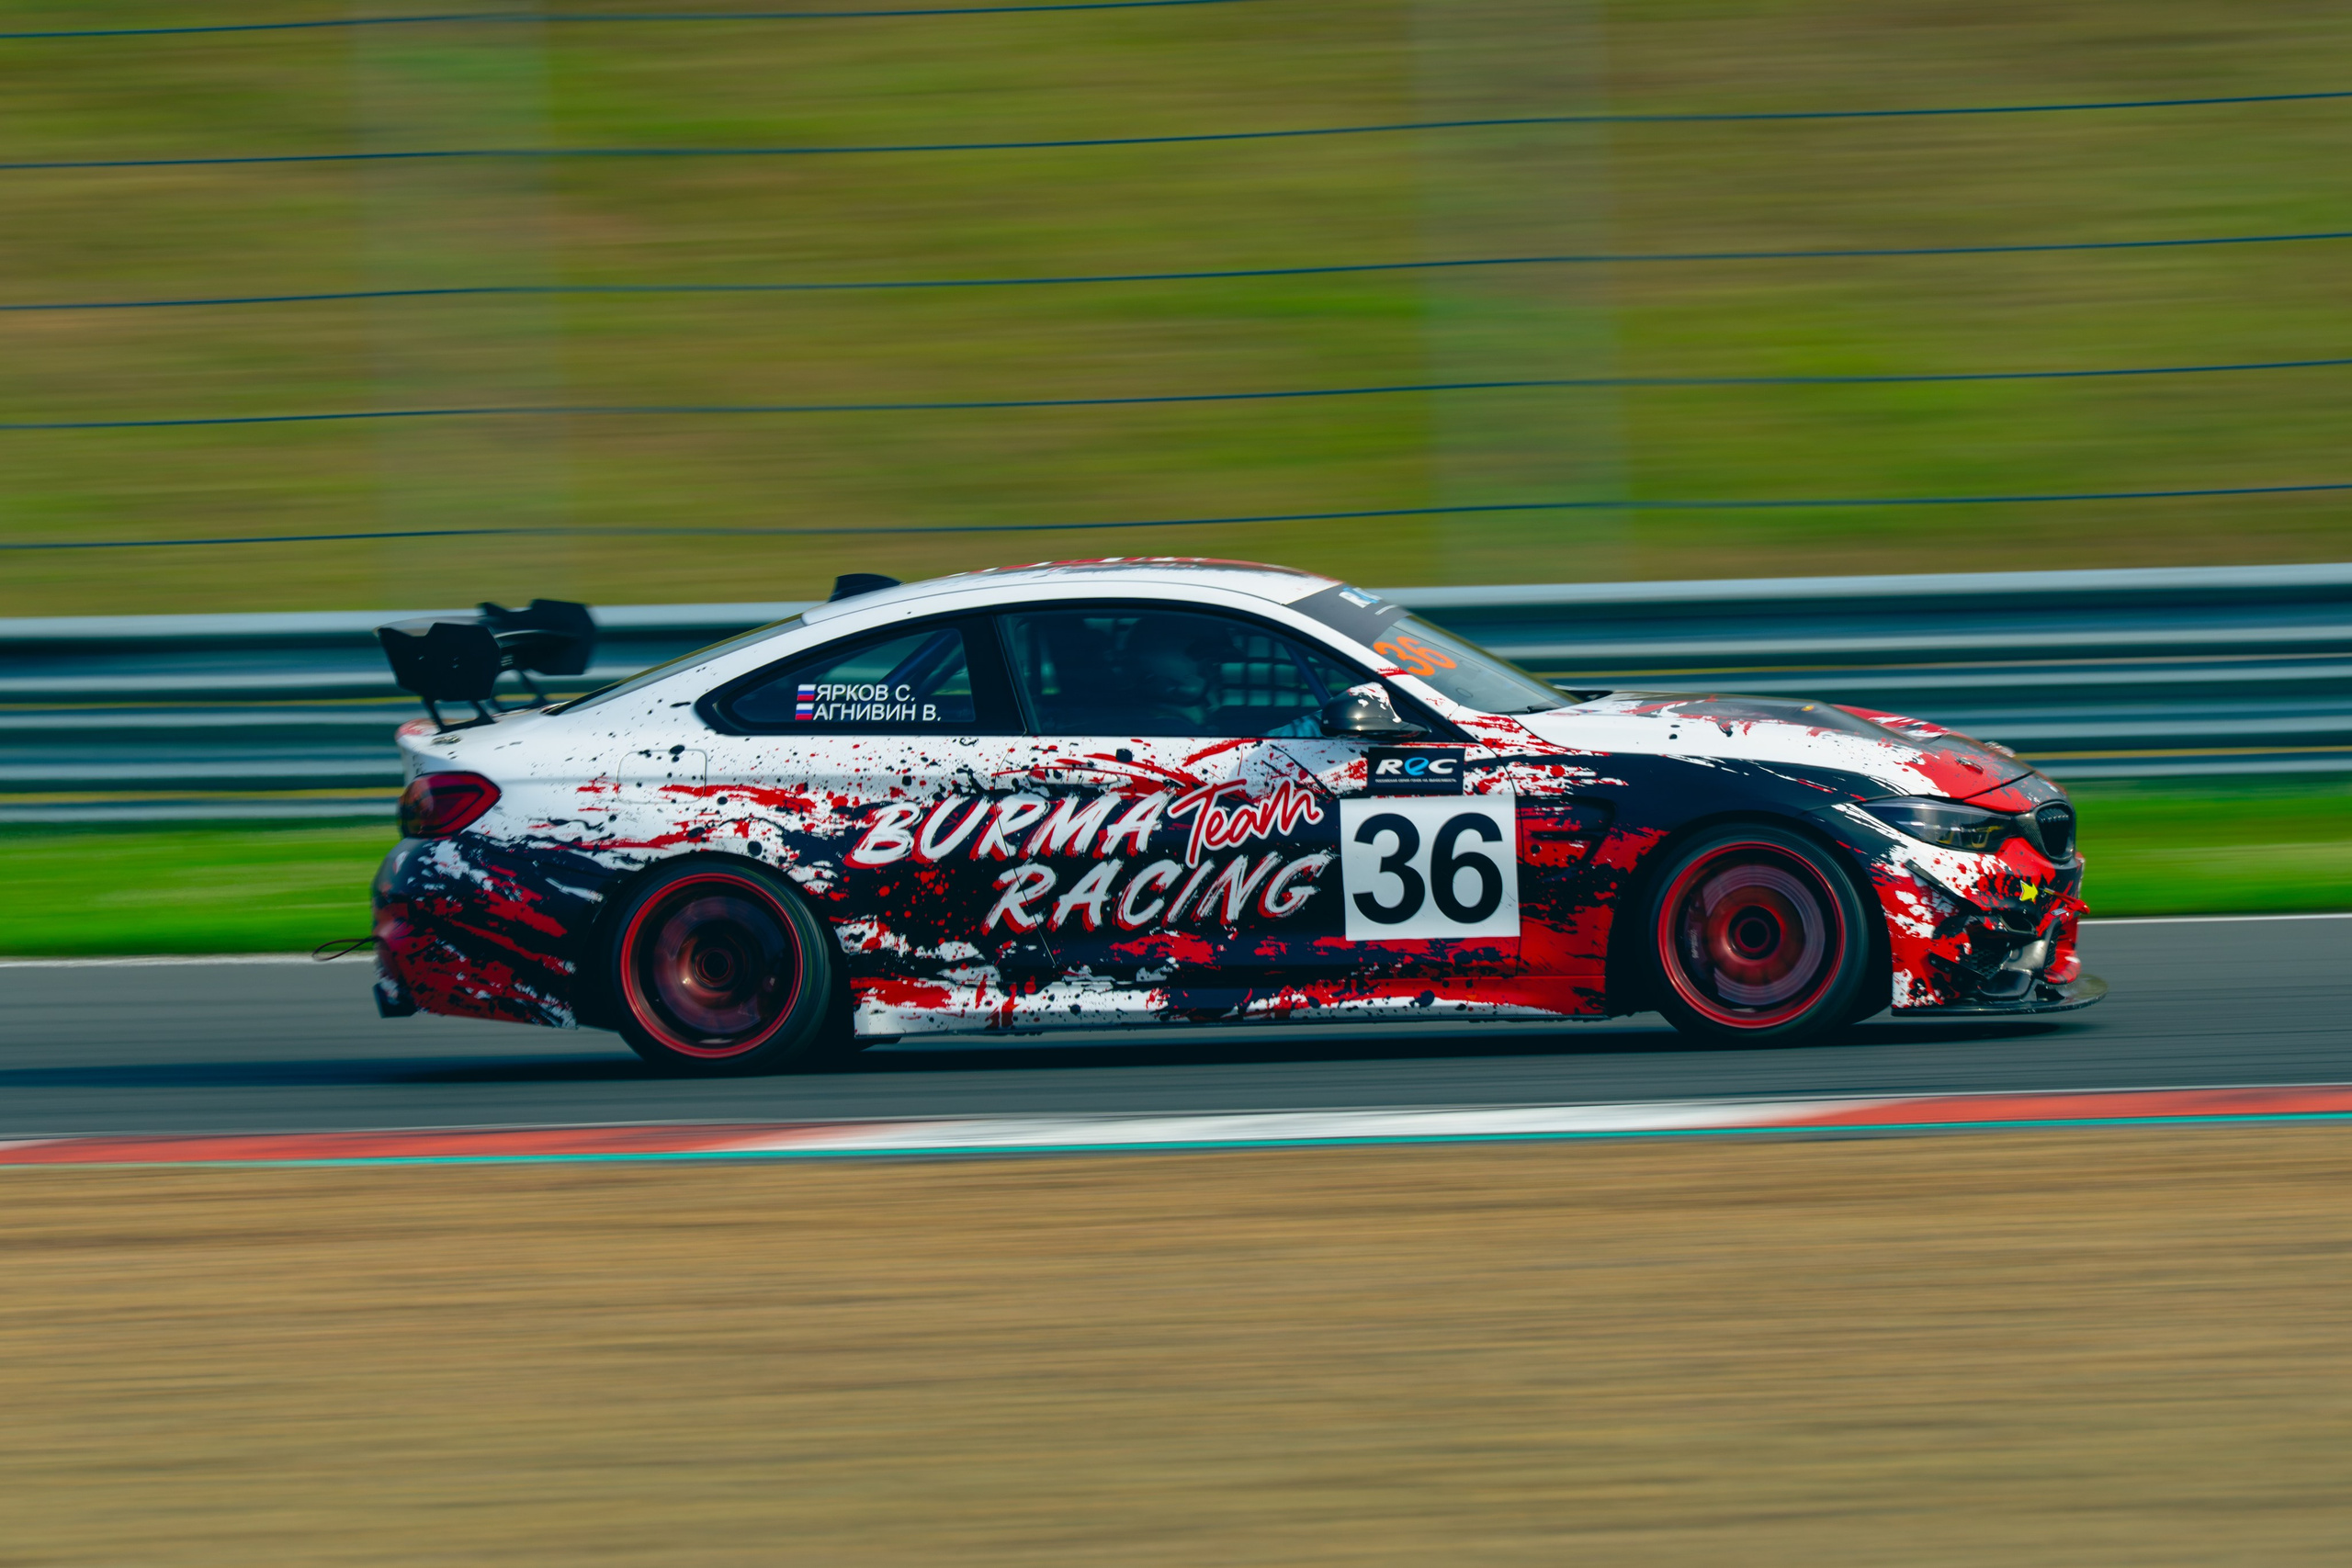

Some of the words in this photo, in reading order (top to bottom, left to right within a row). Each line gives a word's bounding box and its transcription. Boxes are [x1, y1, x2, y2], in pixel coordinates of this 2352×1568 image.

[1373, 636, 1457, 676] 36
[813, 703, 917, 721] АГНИВИН
[922, 704, 942, 722] В.
[815, 683, 889, 702] ЯРКОВ
[895, 683, 916, 702] С.
[842, 788, 1175, 869] BURMA
[1166, 777, 1324, 869] Team
[979, 851, 1338, 935] RACING
[1352, 811, 1504, 925] 36
